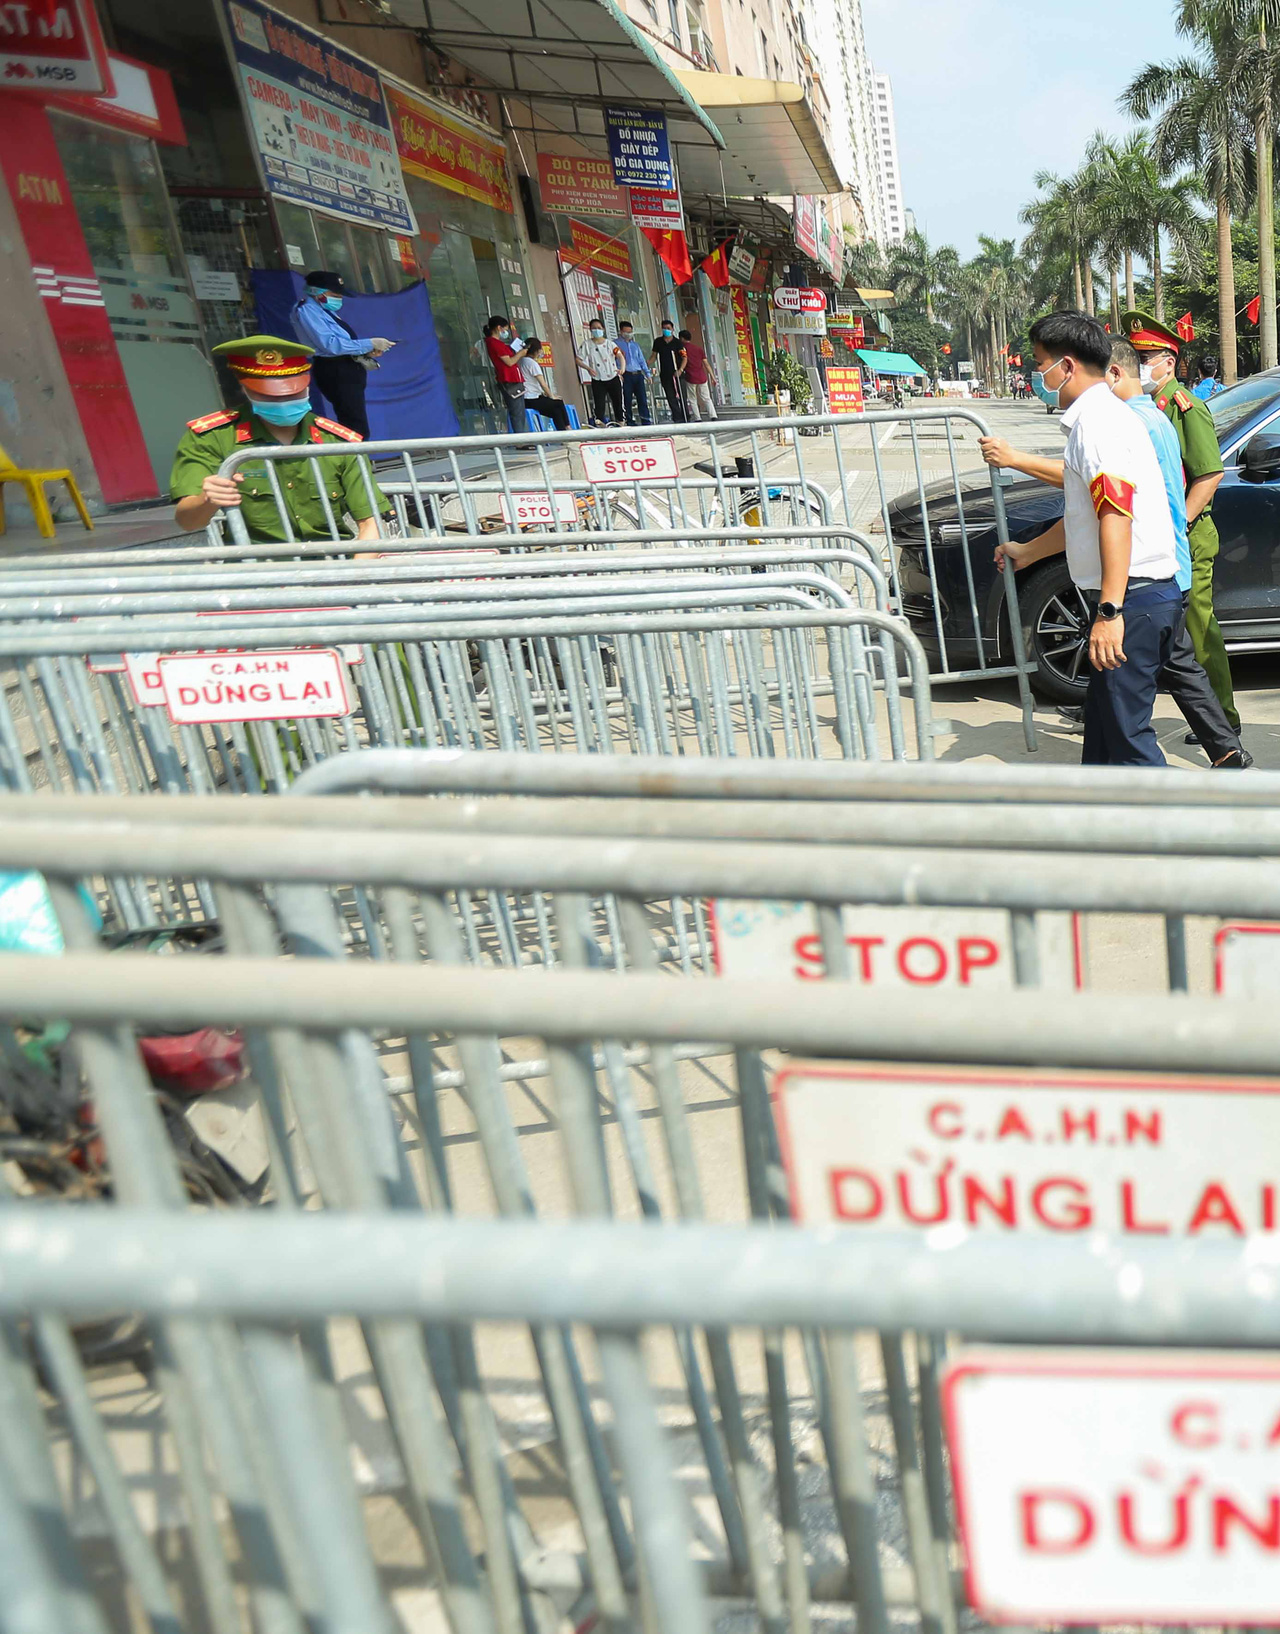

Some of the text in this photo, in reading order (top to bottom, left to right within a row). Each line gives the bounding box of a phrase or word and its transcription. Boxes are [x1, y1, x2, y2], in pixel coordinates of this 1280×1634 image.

[36, 65, 77, 81] MSB
[247, 75, 293, 113] CAMERA
[619, 127, 657, 144] ĐỒ NHỰA
[620, 143, 659, 156] GIÀY DÉP
[552, 157, 571, 170] ĐỒ
[615, 155, 669, 172] ĐỒ GIA DỤNG
[547, 173, 577, 187] QUÀ
[18, 173, 62, 205] ATM
[801, 297, 821, 307] KHÔI
[607, 445, 648, 454] POLICE
[604, 458, 657, 474] STOP
[211, 661, 289, 675] C.A.H.N
[178, 679, 271, 705] DỪNG
[278, 681, 332, 704] LẠI
[793, 934, 1000, 985] STOP
[929, 1100, 1162, 1145] C.A.H.N
[827, 1147, 1093, 1231] DỪNG
